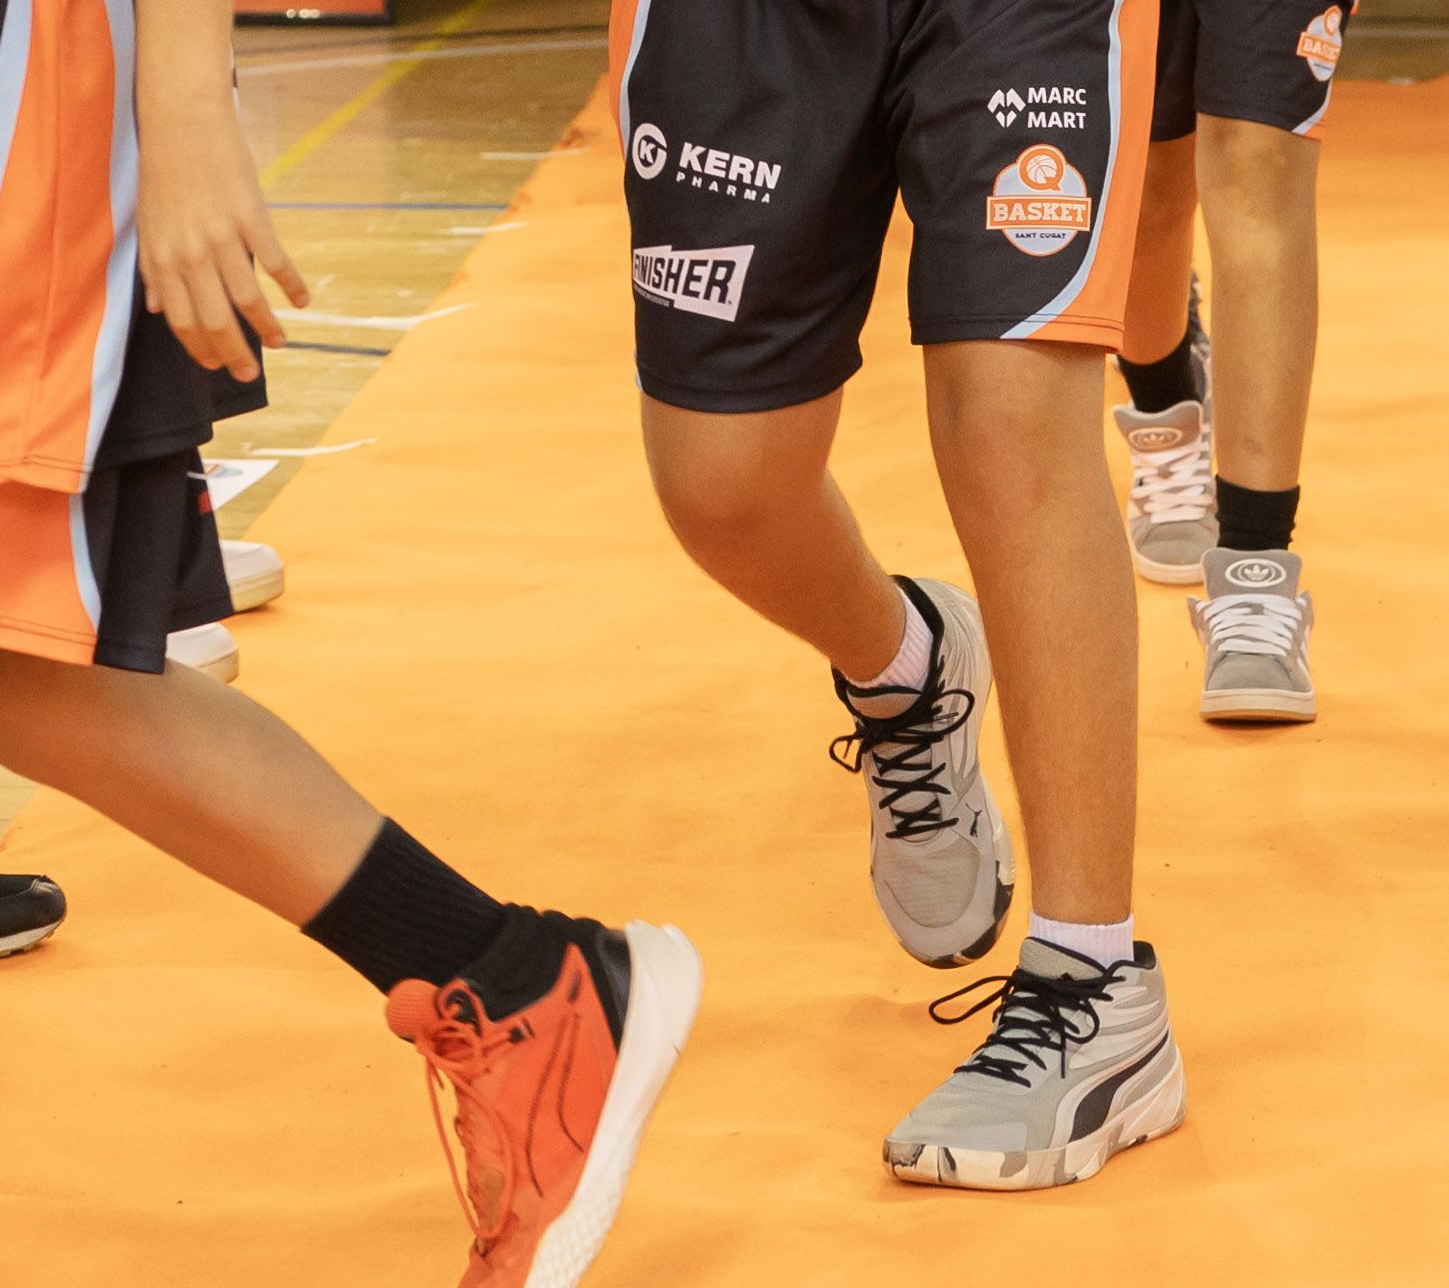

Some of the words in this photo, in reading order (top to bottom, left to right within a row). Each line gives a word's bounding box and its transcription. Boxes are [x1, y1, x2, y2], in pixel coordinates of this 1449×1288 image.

[1026, 86, 1088, 107] MARC
[1026, 110, 1088, 130] MART
[678, 141, 782, 191] KERN
[675, 171, 771, 205] PHARMA
[993, 202, 1088, 224] BASKET
[634, 253, 737, 305] FINISHER
